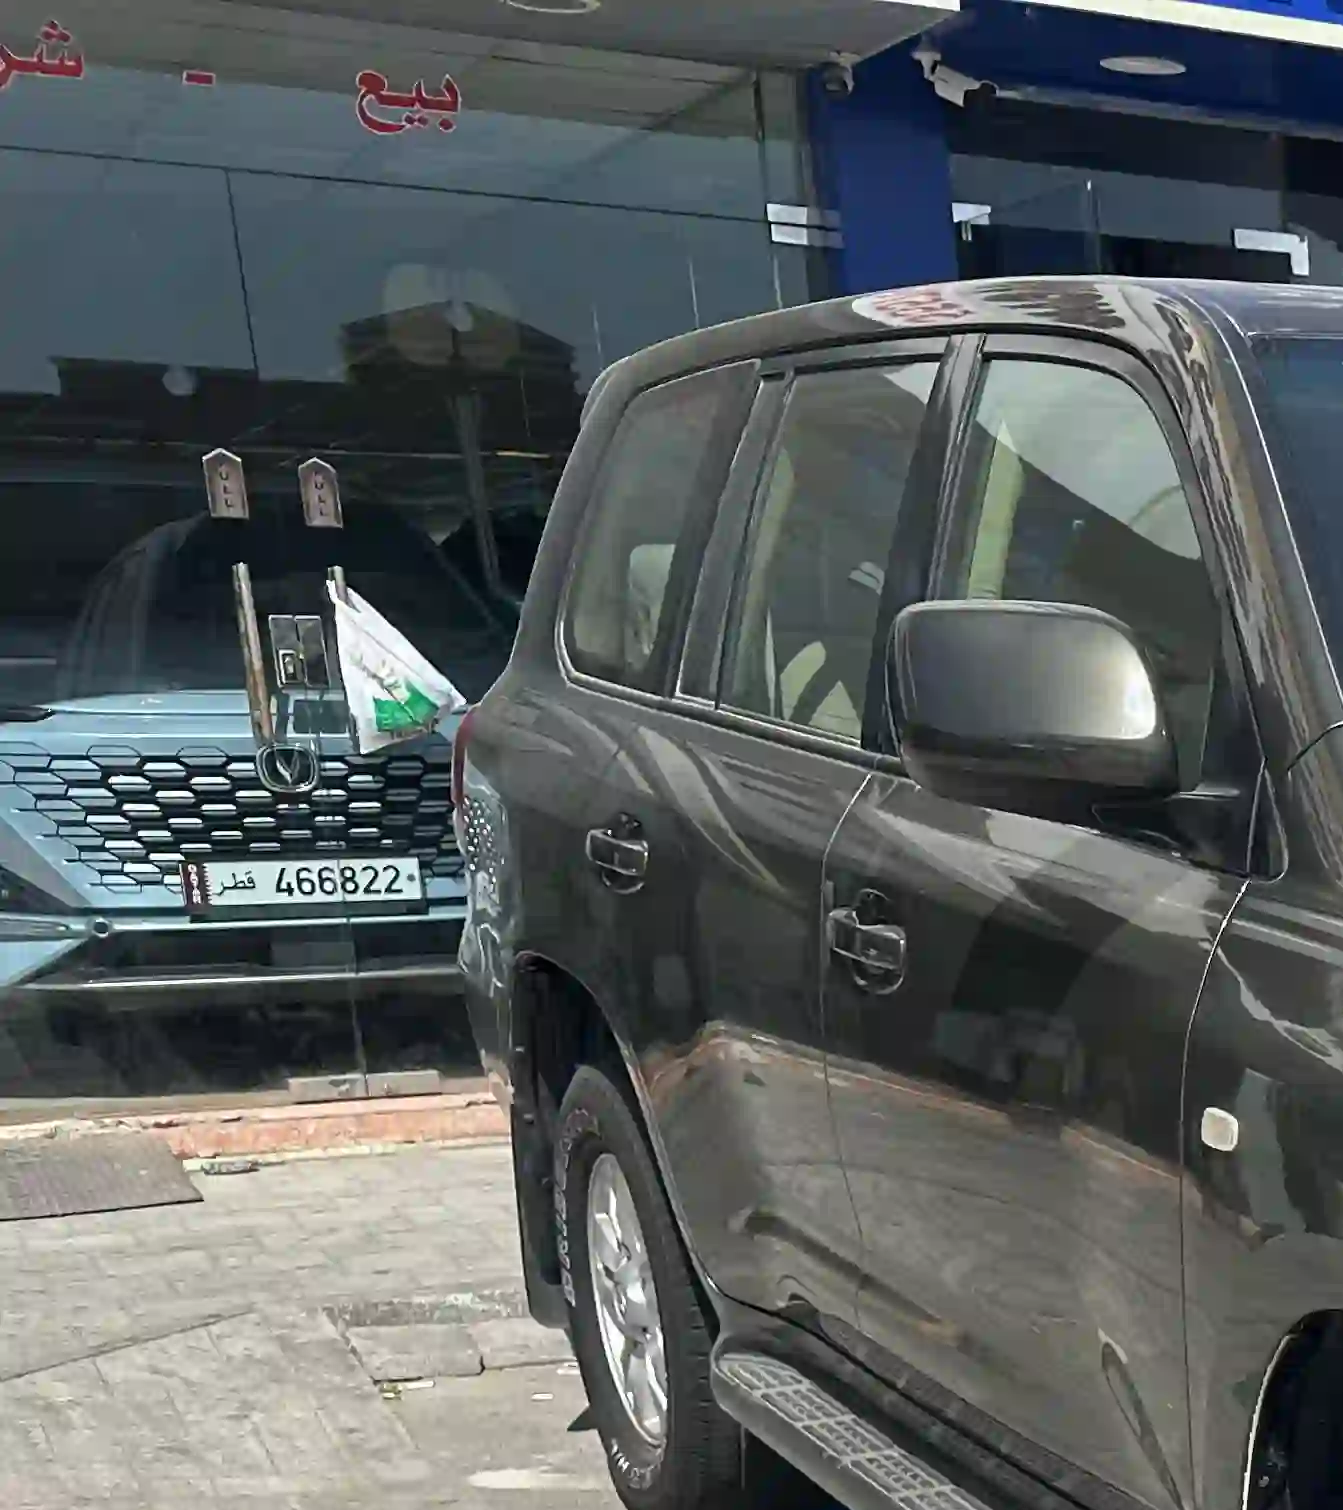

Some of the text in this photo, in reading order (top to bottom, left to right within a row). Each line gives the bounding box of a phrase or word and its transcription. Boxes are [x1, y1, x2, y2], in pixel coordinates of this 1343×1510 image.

[355, 69, 461, 135] بيع
[213, 865, 404, 897] قطر 466822
